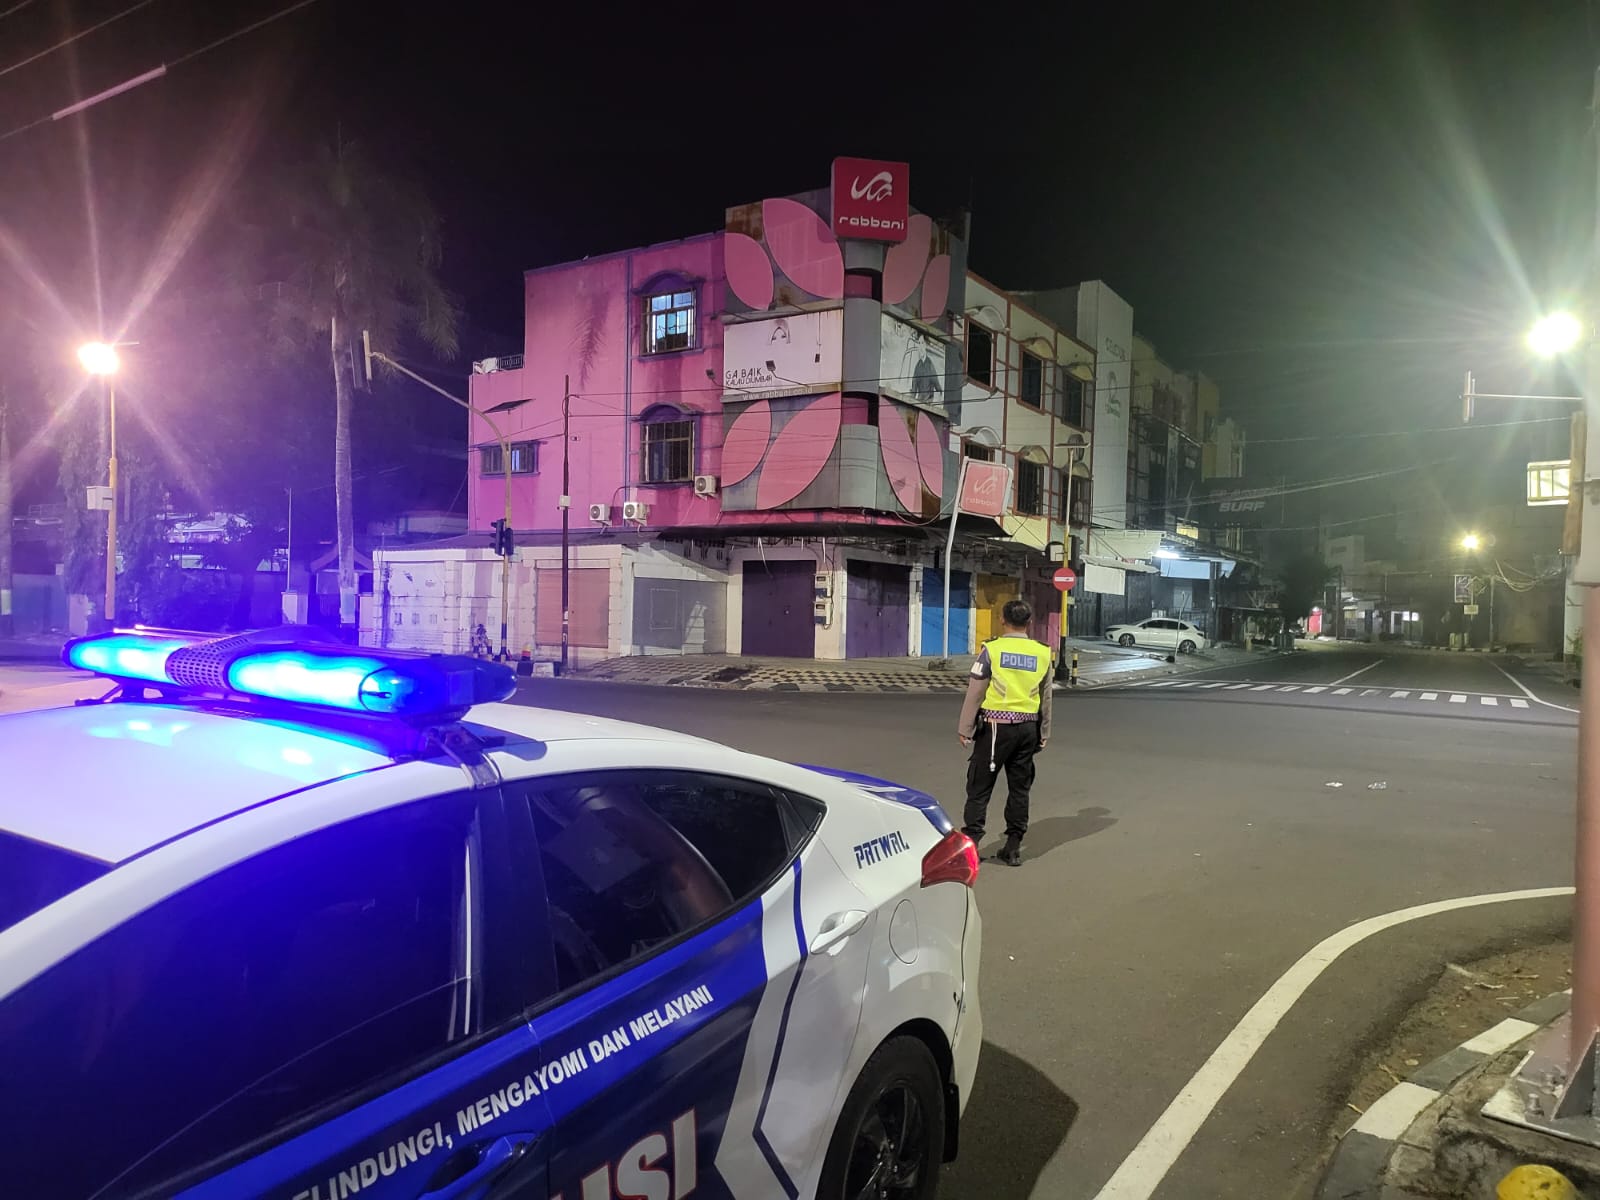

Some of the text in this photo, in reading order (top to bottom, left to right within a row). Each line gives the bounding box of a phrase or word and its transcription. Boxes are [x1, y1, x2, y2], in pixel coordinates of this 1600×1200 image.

[839, 216, 905, 230] rabbani
[726, 368, 762, 380] GA BAIK
[1219, 501, 1266, 512] SURF
[1002, 653, 1037, 670] POLISI
[853, 830, 910, 870] PATWAL
[456, 1048, 588, 1137] MENGAYOMI
[588, 1026, 630, 1064] DAN
[629, 984, 714, 1042] MELAYANI
